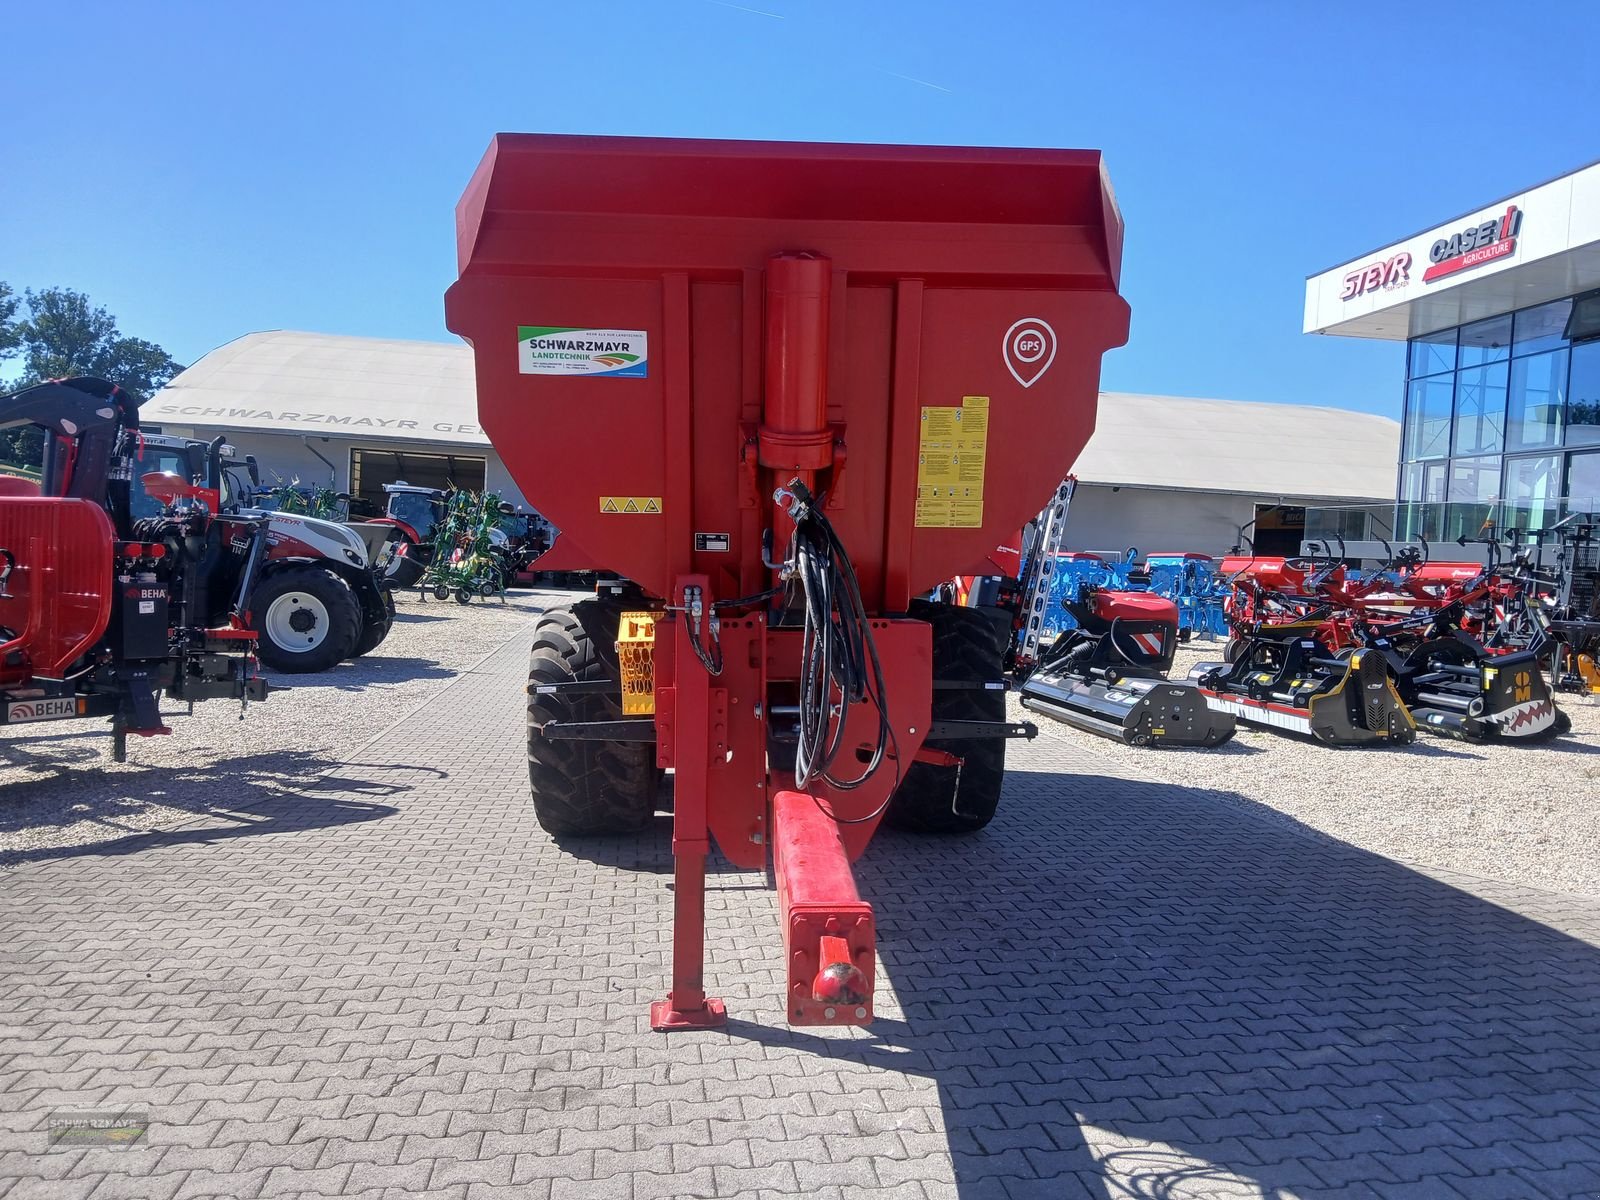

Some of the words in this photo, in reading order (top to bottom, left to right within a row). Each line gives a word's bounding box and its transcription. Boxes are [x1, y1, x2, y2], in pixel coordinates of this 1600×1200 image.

[1462, 243, 1509, 265] AGRICULTURE
[1339, 252, 1412, 301] STEYR
[530, 339, 630, 352] SCHWARZMAYR
[1020, 340, 1040, 351] GPS
[532, 352, 591, 361] LANDTECHNIK
[157, 405, 418, 430] SCHWARZMAYR
[432, 422, 487, 435] GE
[275, 516, 301, 525] STEYR
[141, 589, 166, 599] BEHA
[36, 701, 74, 716] BEHA
